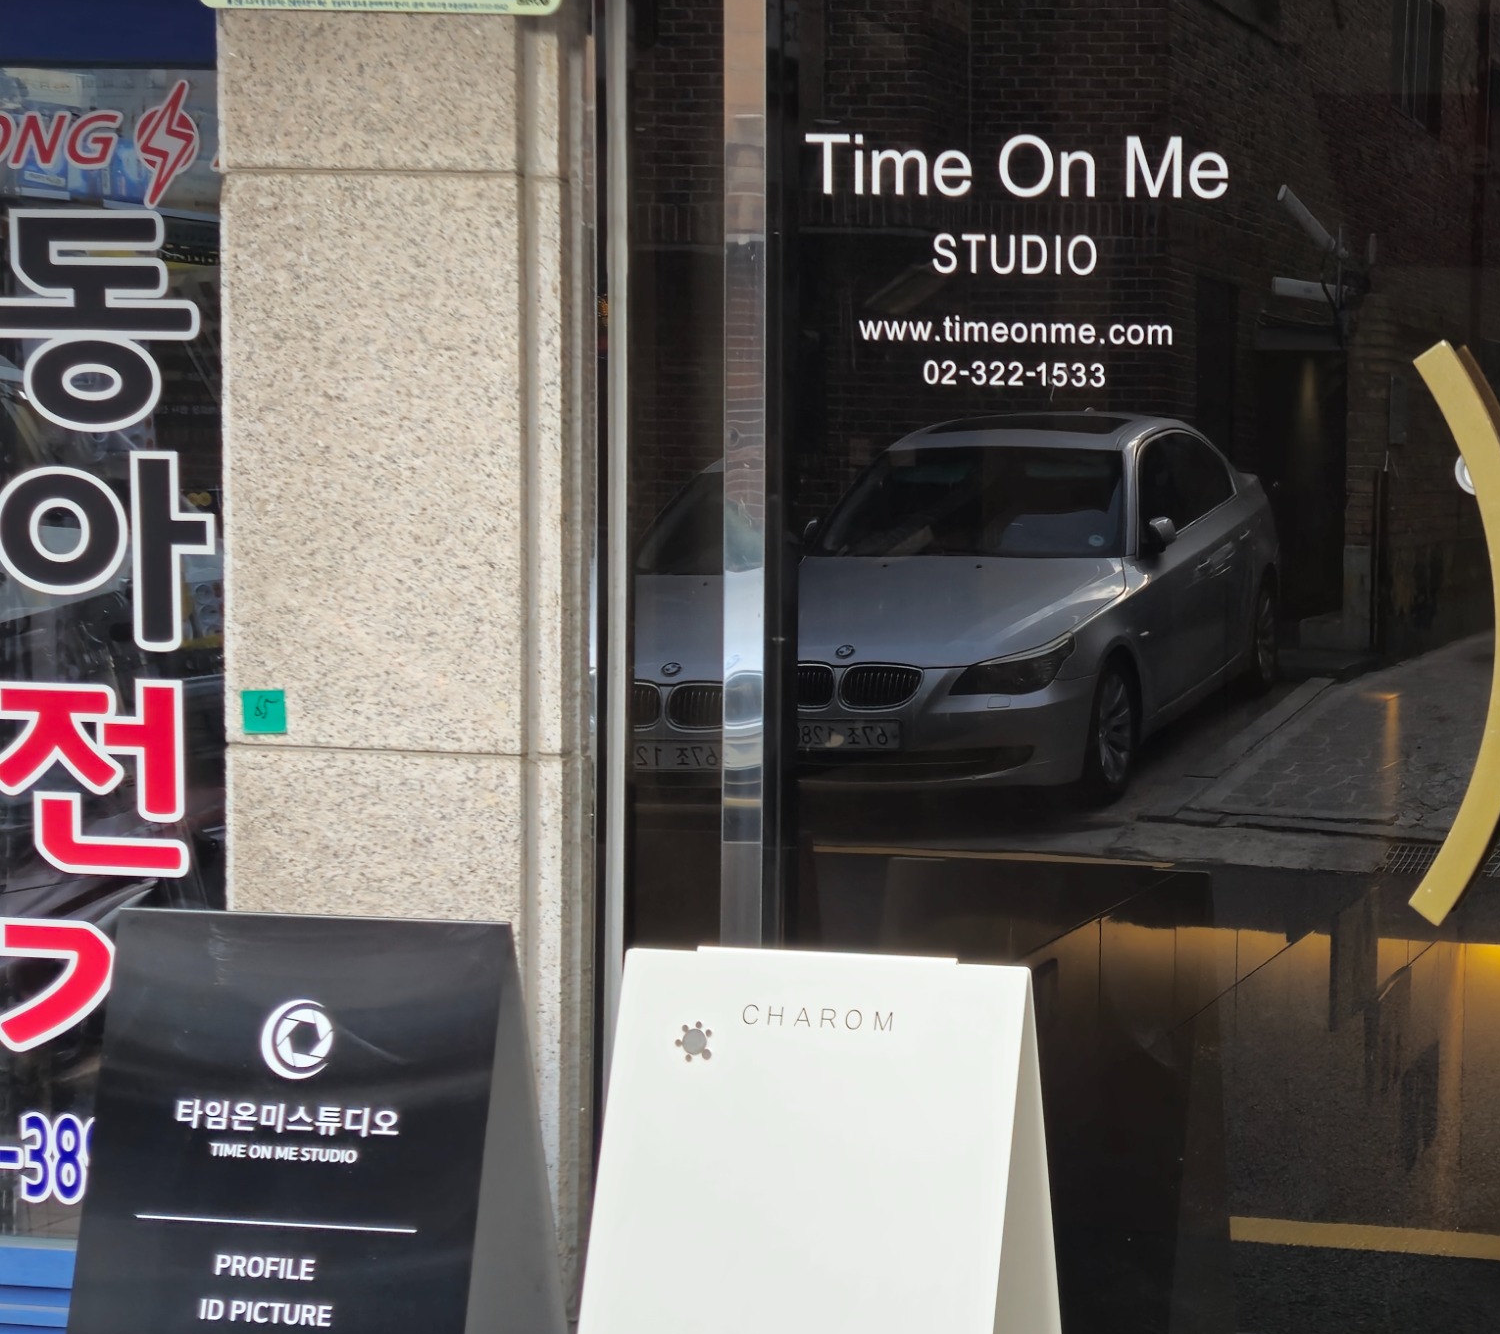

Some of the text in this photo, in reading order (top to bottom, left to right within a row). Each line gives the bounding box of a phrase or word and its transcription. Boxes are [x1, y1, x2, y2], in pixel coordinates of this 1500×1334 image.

[804, 132, 1230, 200] Time On Me
[931, 233, 1098, 276] STUDIO
[858, 314, 1174, 346] www.timeonme.com
[922, 359, 1107, 388] 02-322-1533
[742, 1003, 894, 1032] CHAROM
[175, 1098, 399, 1138] 타임온미스튜디오
[209, 1141, 359, 1164] TIME ON ME STUDIO
[214, 1253, 316, 1281] PROFILE
[199, 1298, 333, 1327] ID PICTURE
